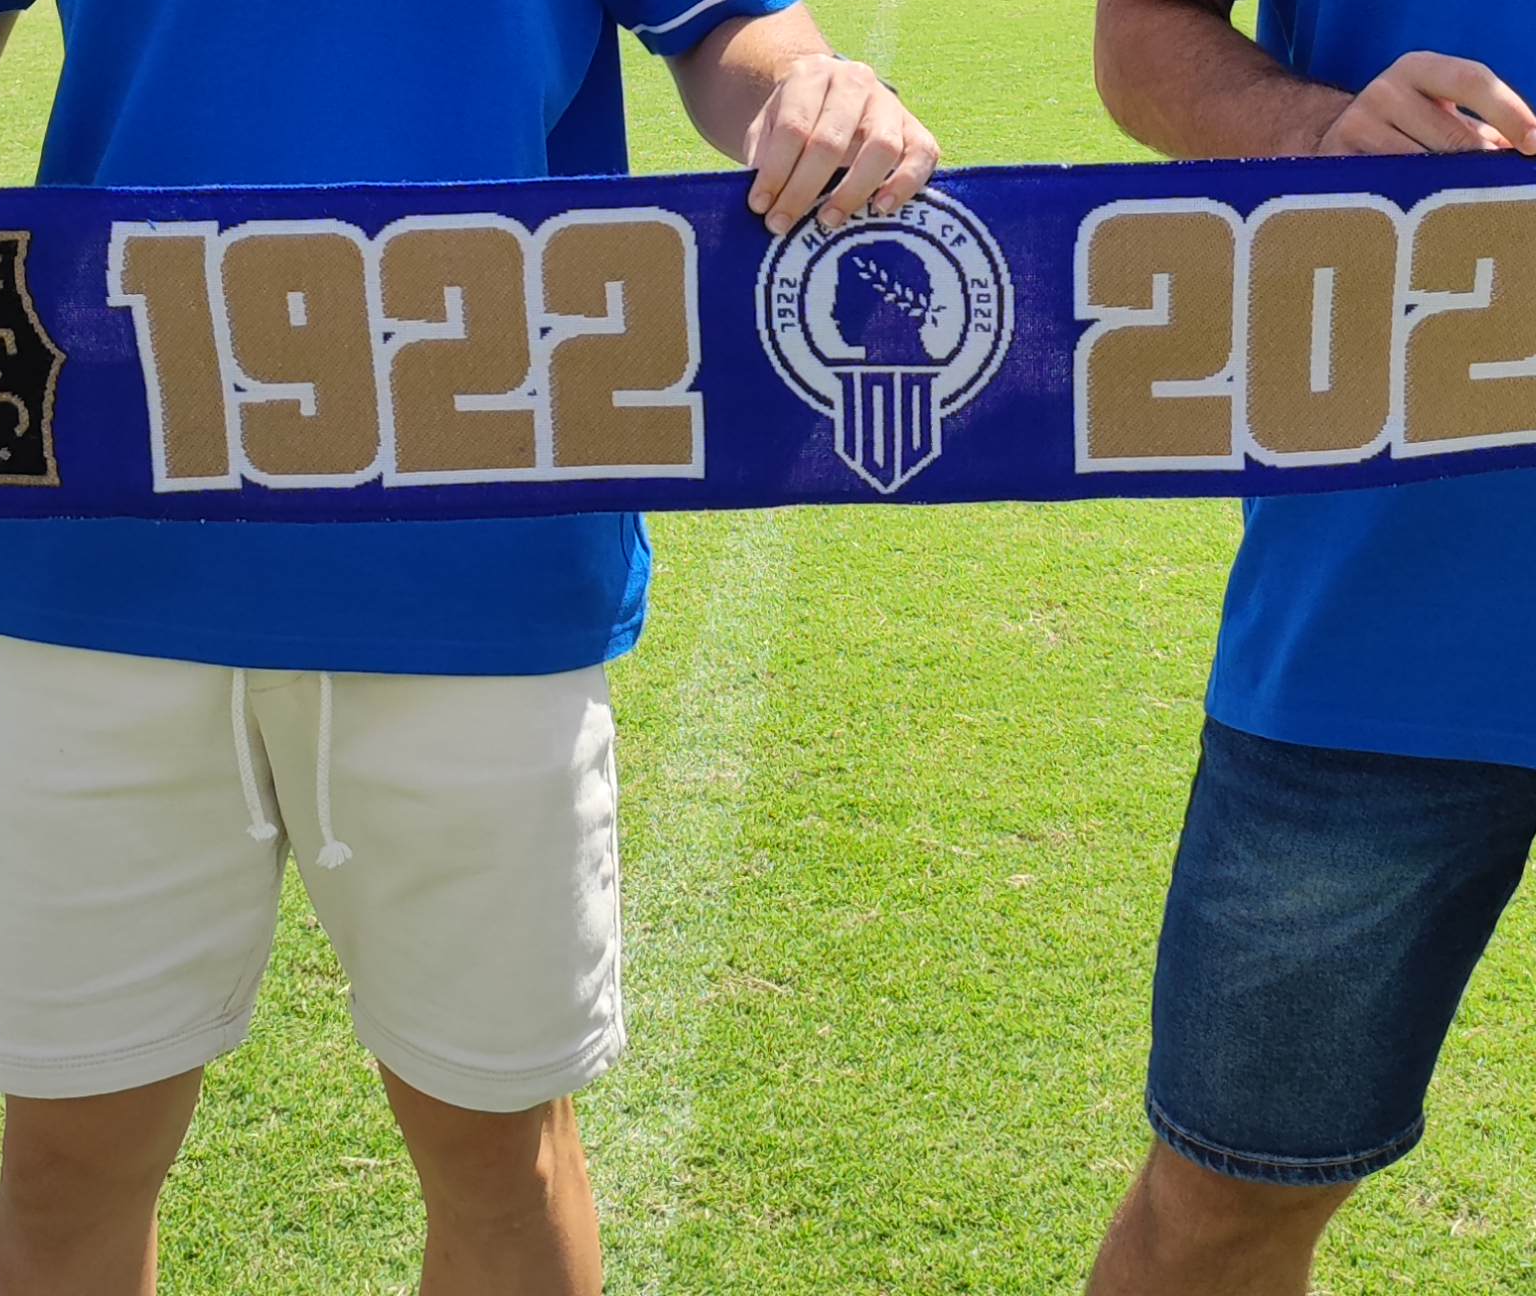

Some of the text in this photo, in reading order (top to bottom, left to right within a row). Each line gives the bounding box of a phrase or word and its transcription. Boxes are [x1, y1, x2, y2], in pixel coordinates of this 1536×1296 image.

[777, 277, 797, 333] 1922
[971, 278, 992, 333] 2022
[106, 206, 705, 492] 1922
